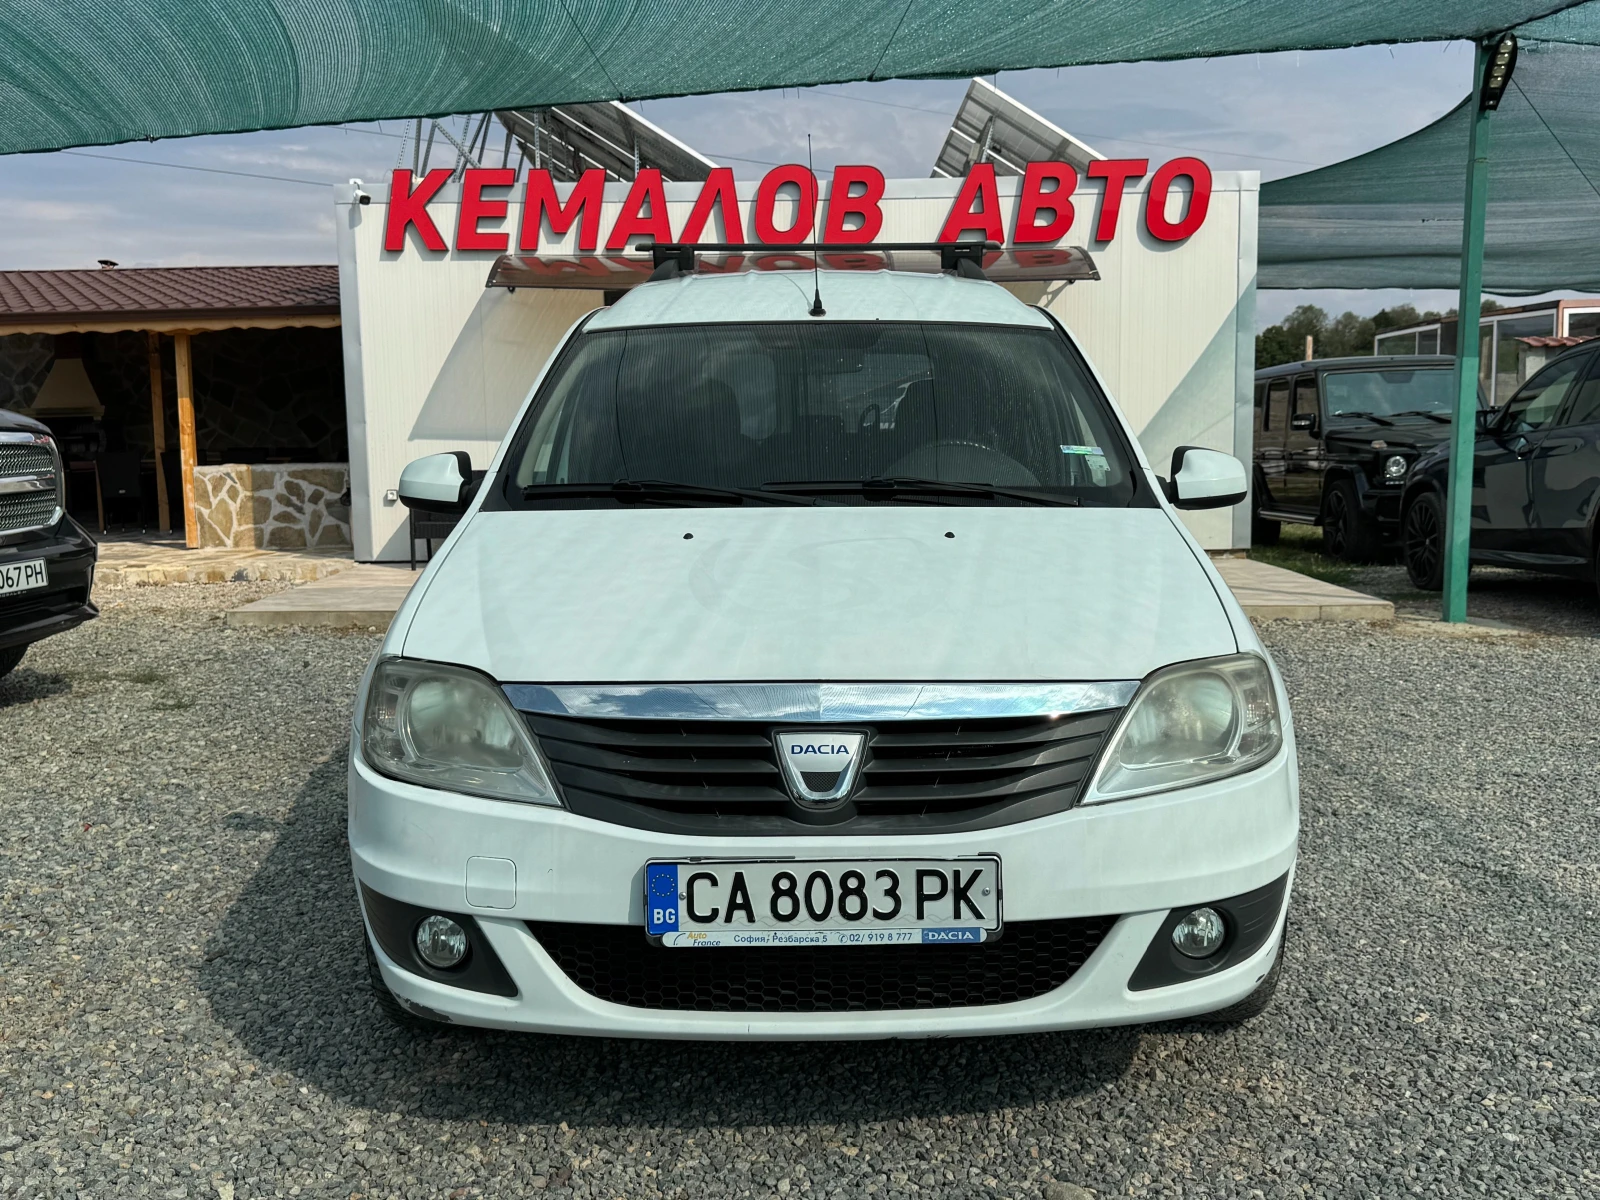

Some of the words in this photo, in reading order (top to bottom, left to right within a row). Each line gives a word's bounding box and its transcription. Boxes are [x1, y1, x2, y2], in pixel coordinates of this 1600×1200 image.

[384, 164, 885, 251] КЕМАЛОВ
[937, 157, 1211, 245] АВТО
[24, 563, 45, 586] PH
[791, 744, 850, 755] DACIA
[686, 871, 756, 923] CA
[770, 869, 902, 922] 8083
[915, 868, 986, 920] PK
[653, 908, 676, 924] BG
[687, 932, 707, 940] Auto
[822, 935, 828, 943] 5
[867, 933, 885, 942] 919
[887, 933, 893, 942] 8
[896, 932, 913, 941] 777
[928, 931, 974, 940] DACIA
[692, 938, 721, 947] France
